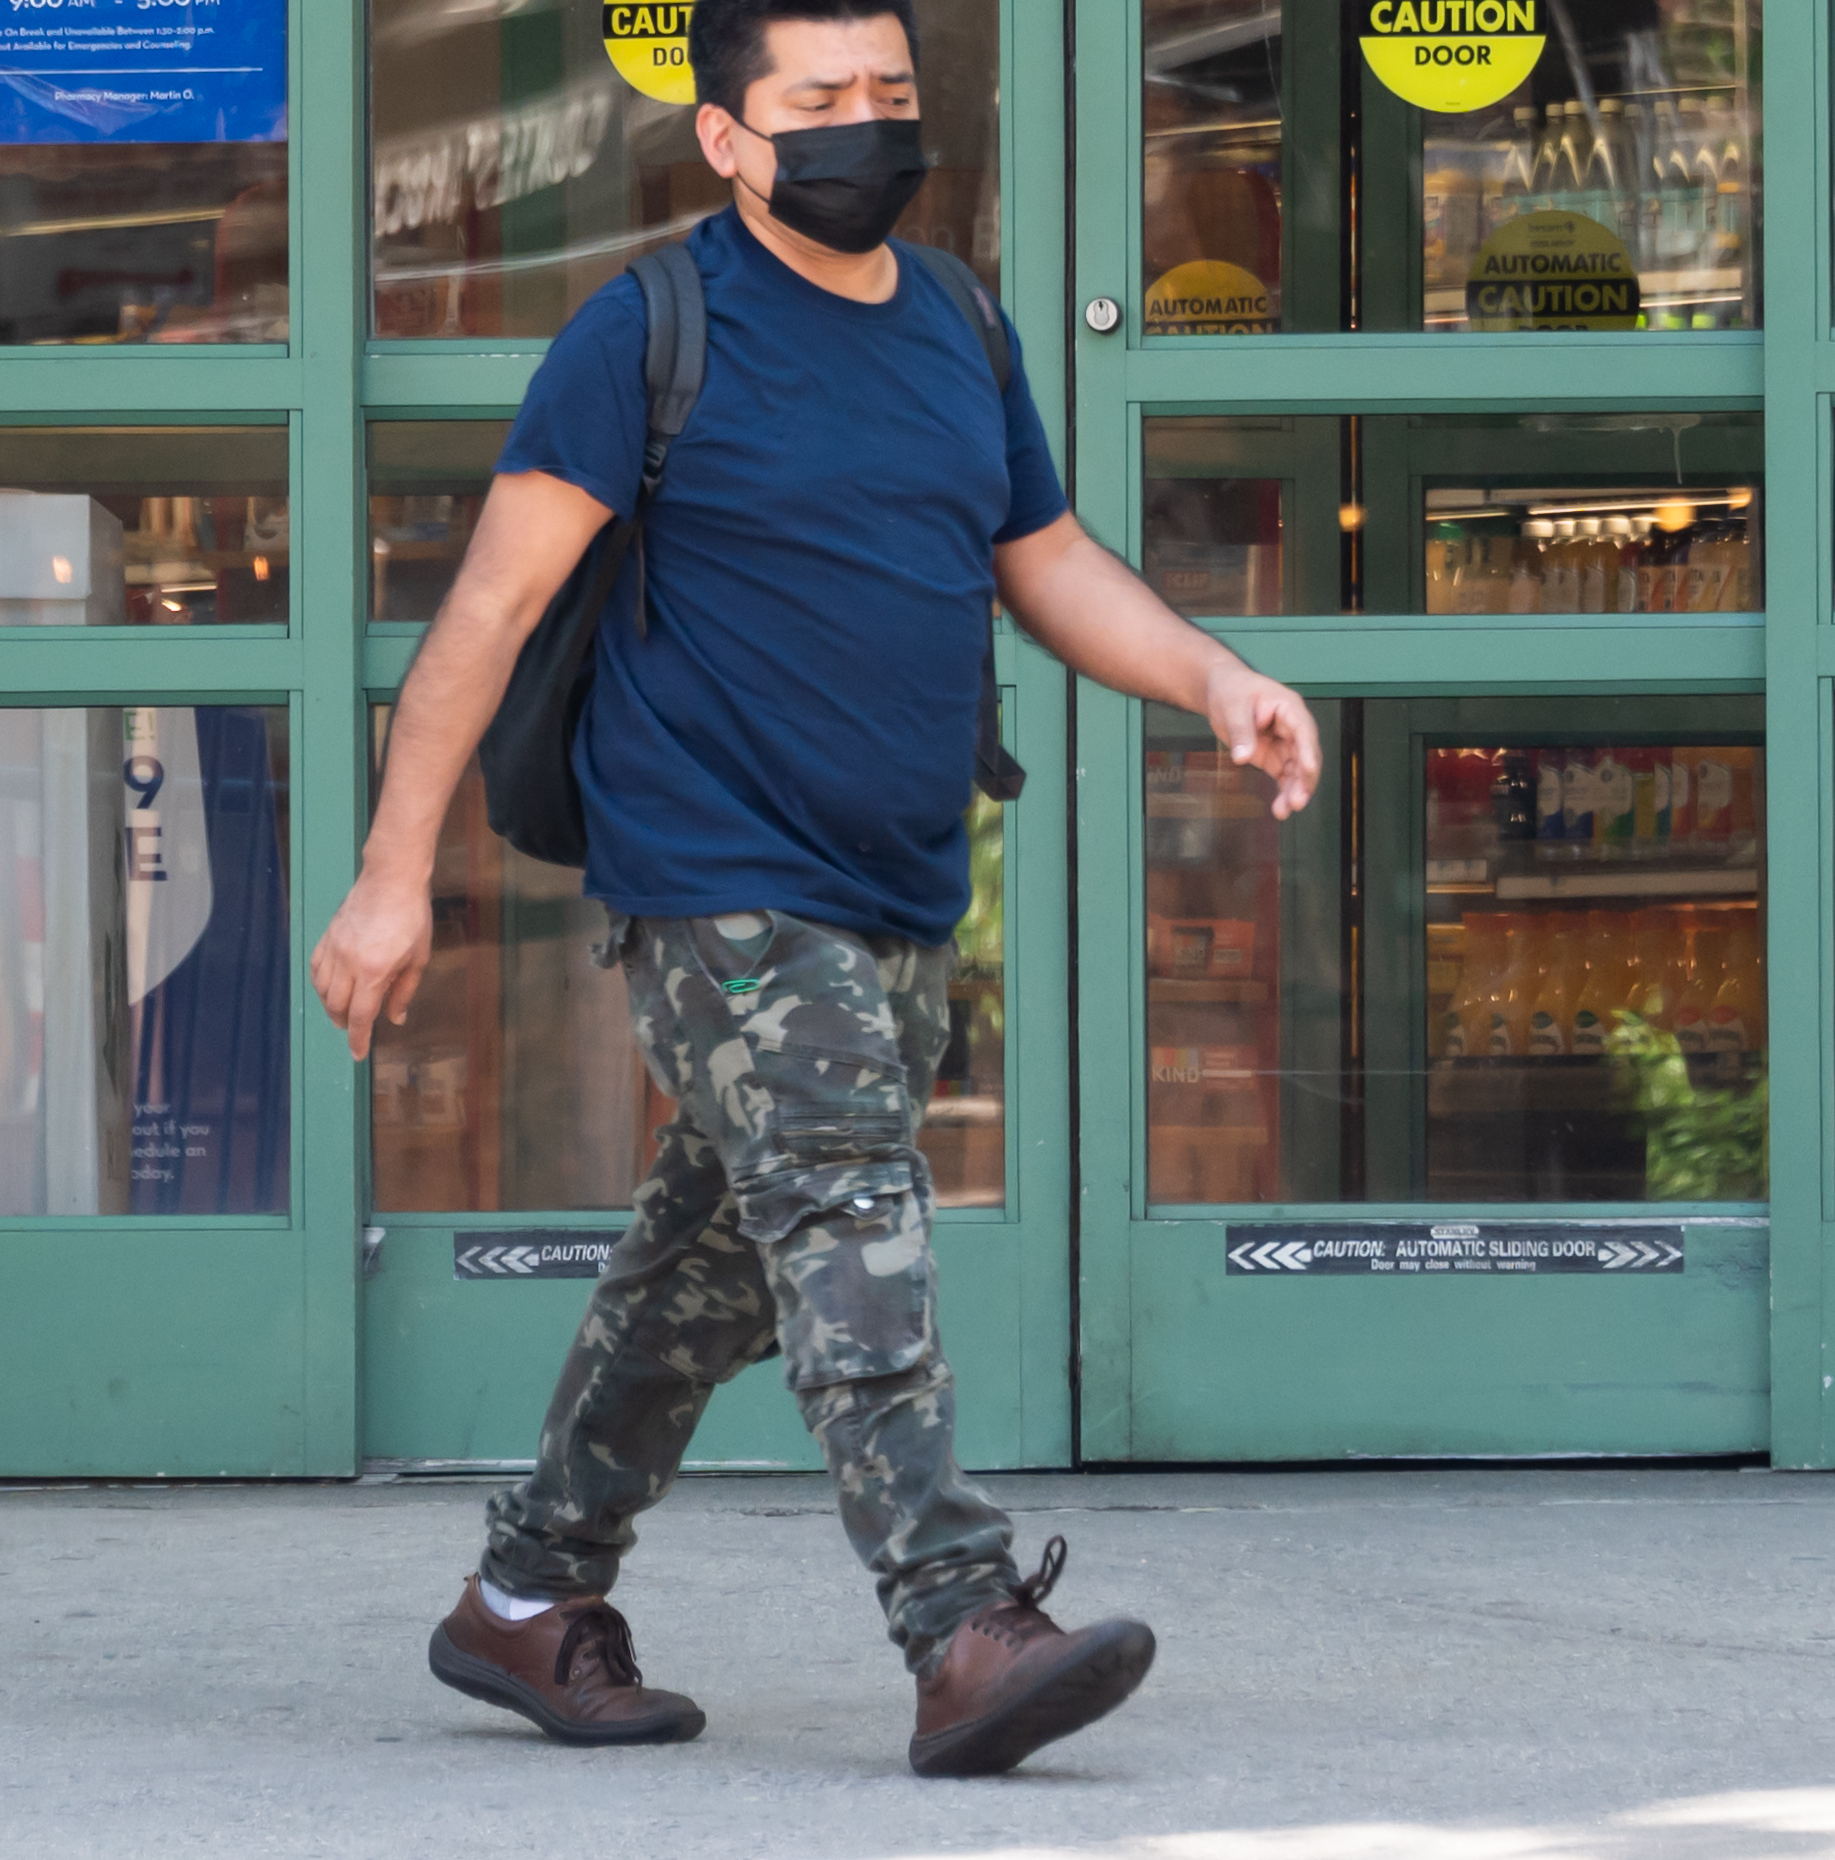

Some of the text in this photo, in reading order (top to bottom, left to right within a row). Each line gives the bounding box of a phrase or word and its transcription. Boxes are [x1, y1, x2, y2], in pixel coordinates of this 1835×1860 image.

[611, 7, 693, 35] CAUT
[1370, 0, 1535, 33] CAUTION
[653, 47, 684, 66] DO
[1415, 44, 1491, 66] DOOR
[1483, 252, 1622, 274] AUTOMATIC
[1149, 296, 1268, 316] AUTOMATIC
[1477, 283, 1628, 315] CAUTION
[541, 1244, 613, 1261] CAUTION:
[1314, 1240, 1596, 1258] CAUTION: AUTOMATIC SLIDING DOOR
[1370, 1258, 1537, 1272] Door may close without warning
